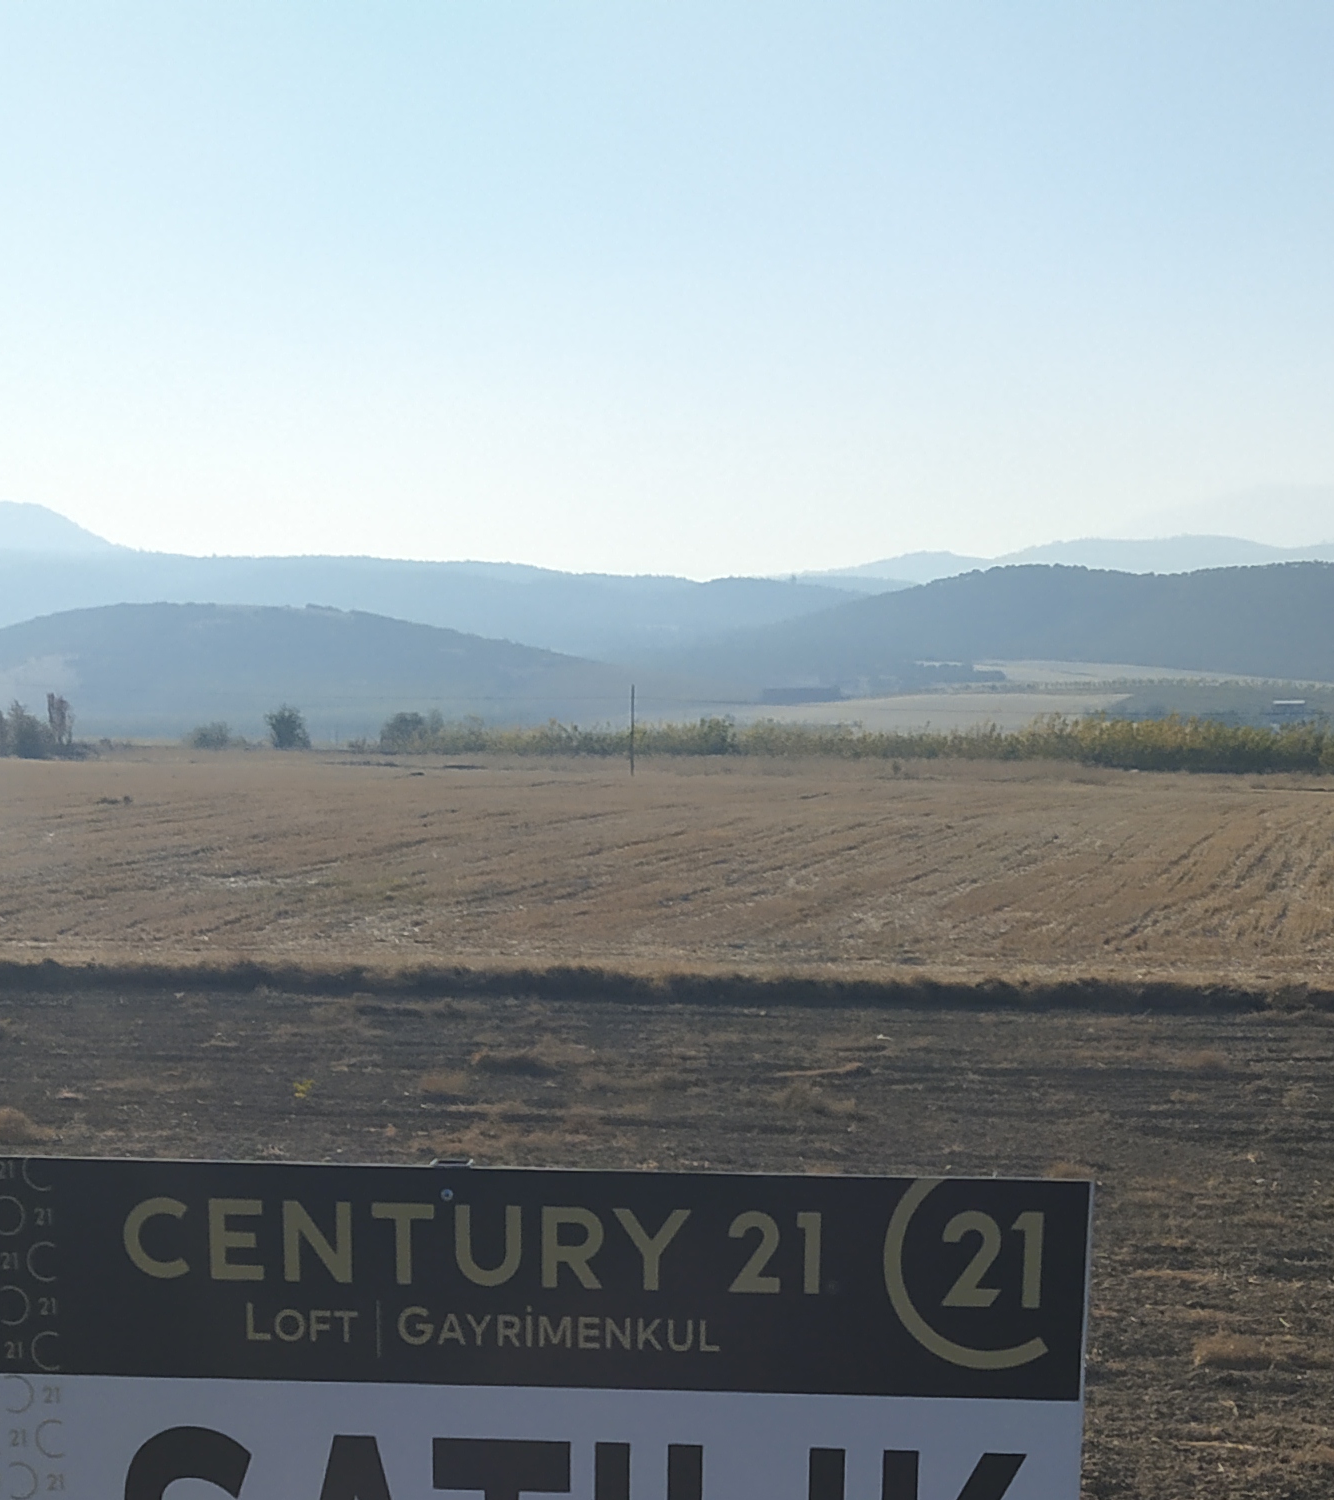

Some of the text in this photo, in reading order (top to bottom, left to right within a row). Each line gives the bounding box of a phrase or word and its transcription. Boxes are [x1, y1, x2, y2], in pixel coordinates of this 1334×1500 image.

[123, 1197, 822, 1295] CENTURY 21
[245, 1303, 721, 1353] LOFT GAYRİMENKUL
